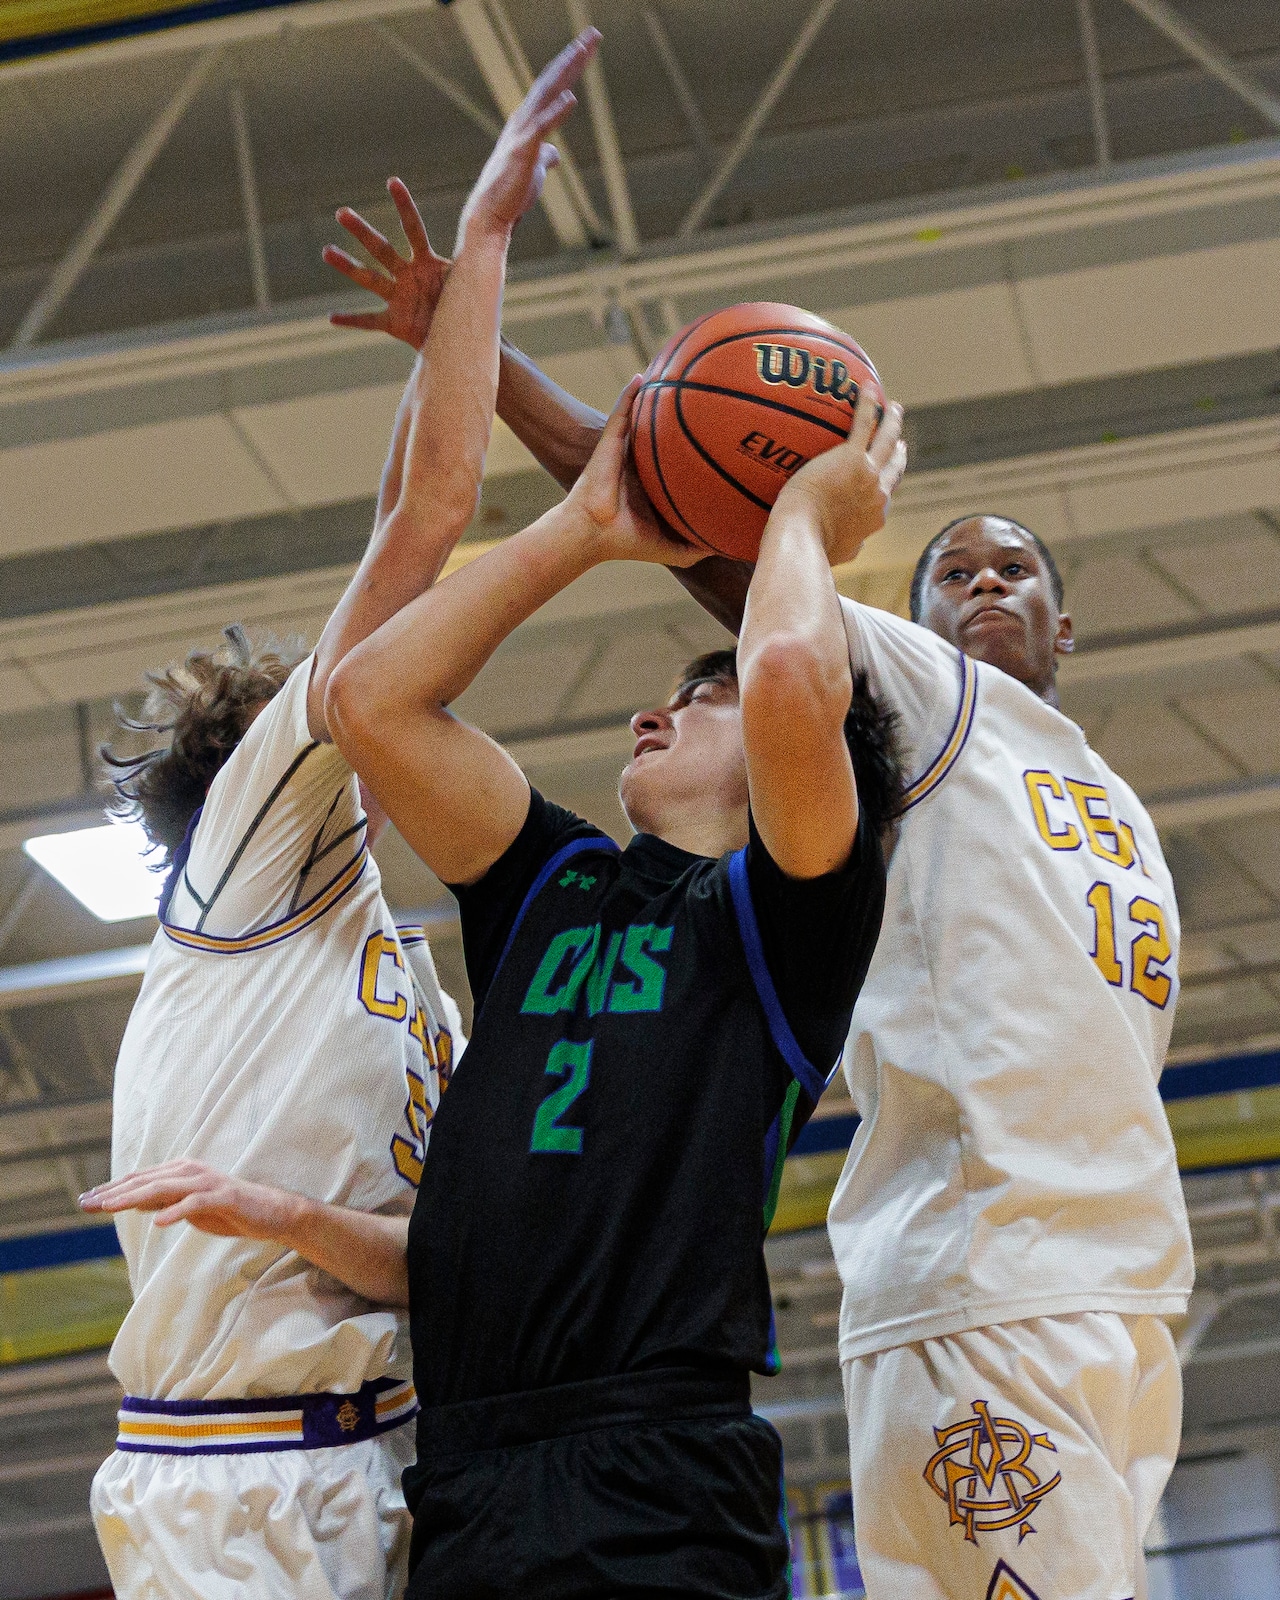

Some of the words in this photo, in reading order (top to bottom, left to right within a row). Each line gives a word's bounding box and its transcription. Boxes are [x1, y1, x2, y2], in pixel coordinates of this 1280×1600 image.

[519, 921, 676, 1017] CNS
[1086, 880, 1172, 1011] 12
[529, 1037, 594, 1154] 2
